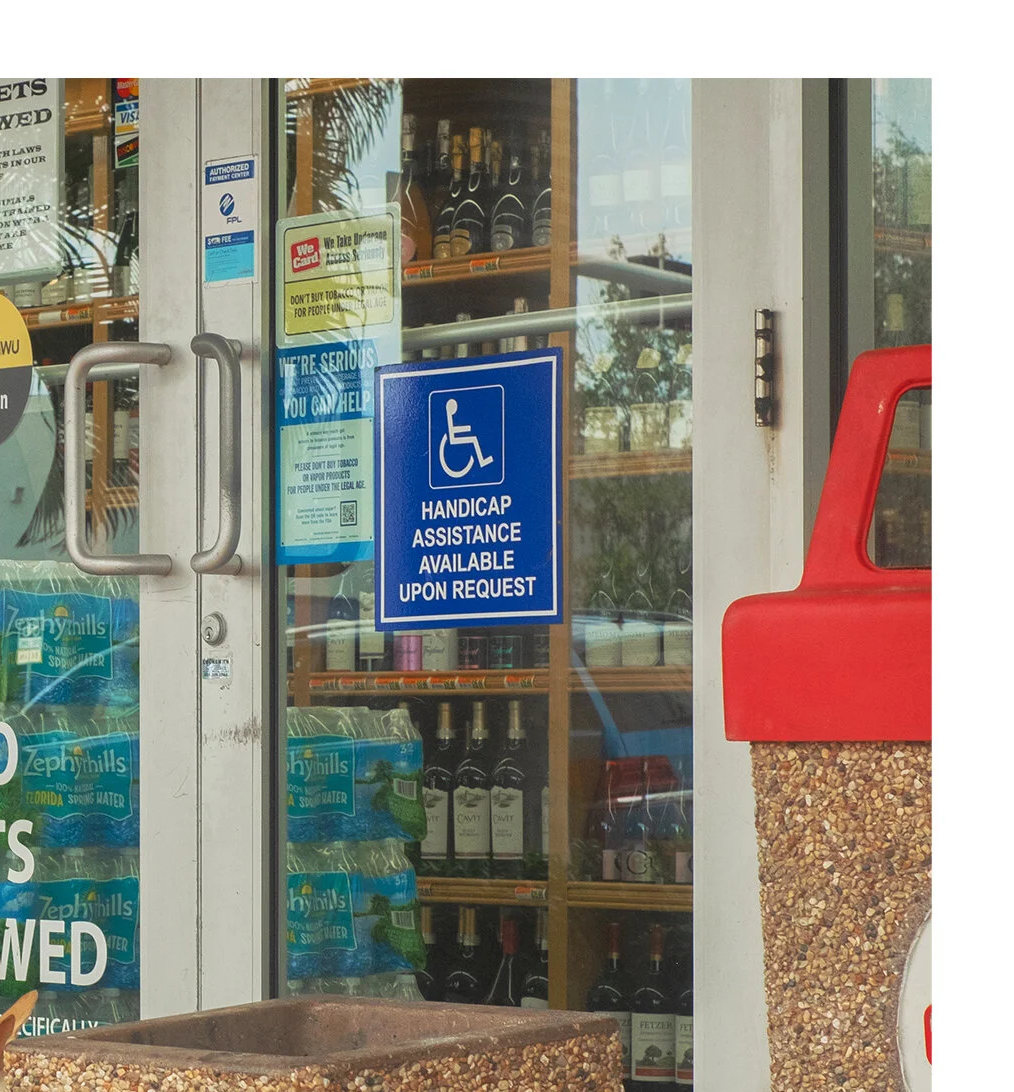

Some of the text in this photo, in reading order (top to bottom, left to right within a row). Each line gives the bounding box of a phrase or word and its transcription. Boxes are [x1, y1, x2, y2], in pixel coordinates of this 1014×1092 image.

[11, 144, 43, 156] LAWS
[10, 158, 23, 167] IN
[22, 155, 47, 167] OUR
[209, 162, 250, 177] AUTHORIZED
[231, 170, 250, 179] CENTER
[226, 216, 243, 225] FPL
[323, 236, 335, 250] We
[336, 232, 352, 248] Take
[296, 243, 315, 256] We
[292, 252, 319, 268] Card
[290, 291, 311, 306] DON'T
[311, 289, 325, 303] BUY
[294, 305, 307, 319] FOR
[307, 302, 330, 317] PEOPLE
[1, 339, 20, 355] WU
[278, 347, 375, 379] WE'RE SERIOUS
[283, 396, 307, 420] YOU
[340, 390, 371, 414] HELP
[294, 461, 312, 472] PLEASE
[326, 460, 336, 469] BUY
[337, 457, 359, 468] TOBACCO
[325, 470, 350, 480] PRODUCTS
[287, 485, 296, 495] FOR
[297, 484, 314, 494] PEOPLE
[315, 483, 330, 493] UNDER
[340, 481, 355, 490] LEGAL
[421, 495, 512, 520] HANDICAP
[412, 522, 522, 548] ASSISTANCE
[418, 550, 515, 575] AVAILABLE
[399, 576, 537, 602] UPON REQUEST
[26, 791, 64, 808] FLORIDA
[96, 792, 125, 808] WATER
[639, 1021, 674, 1030] FETZER
